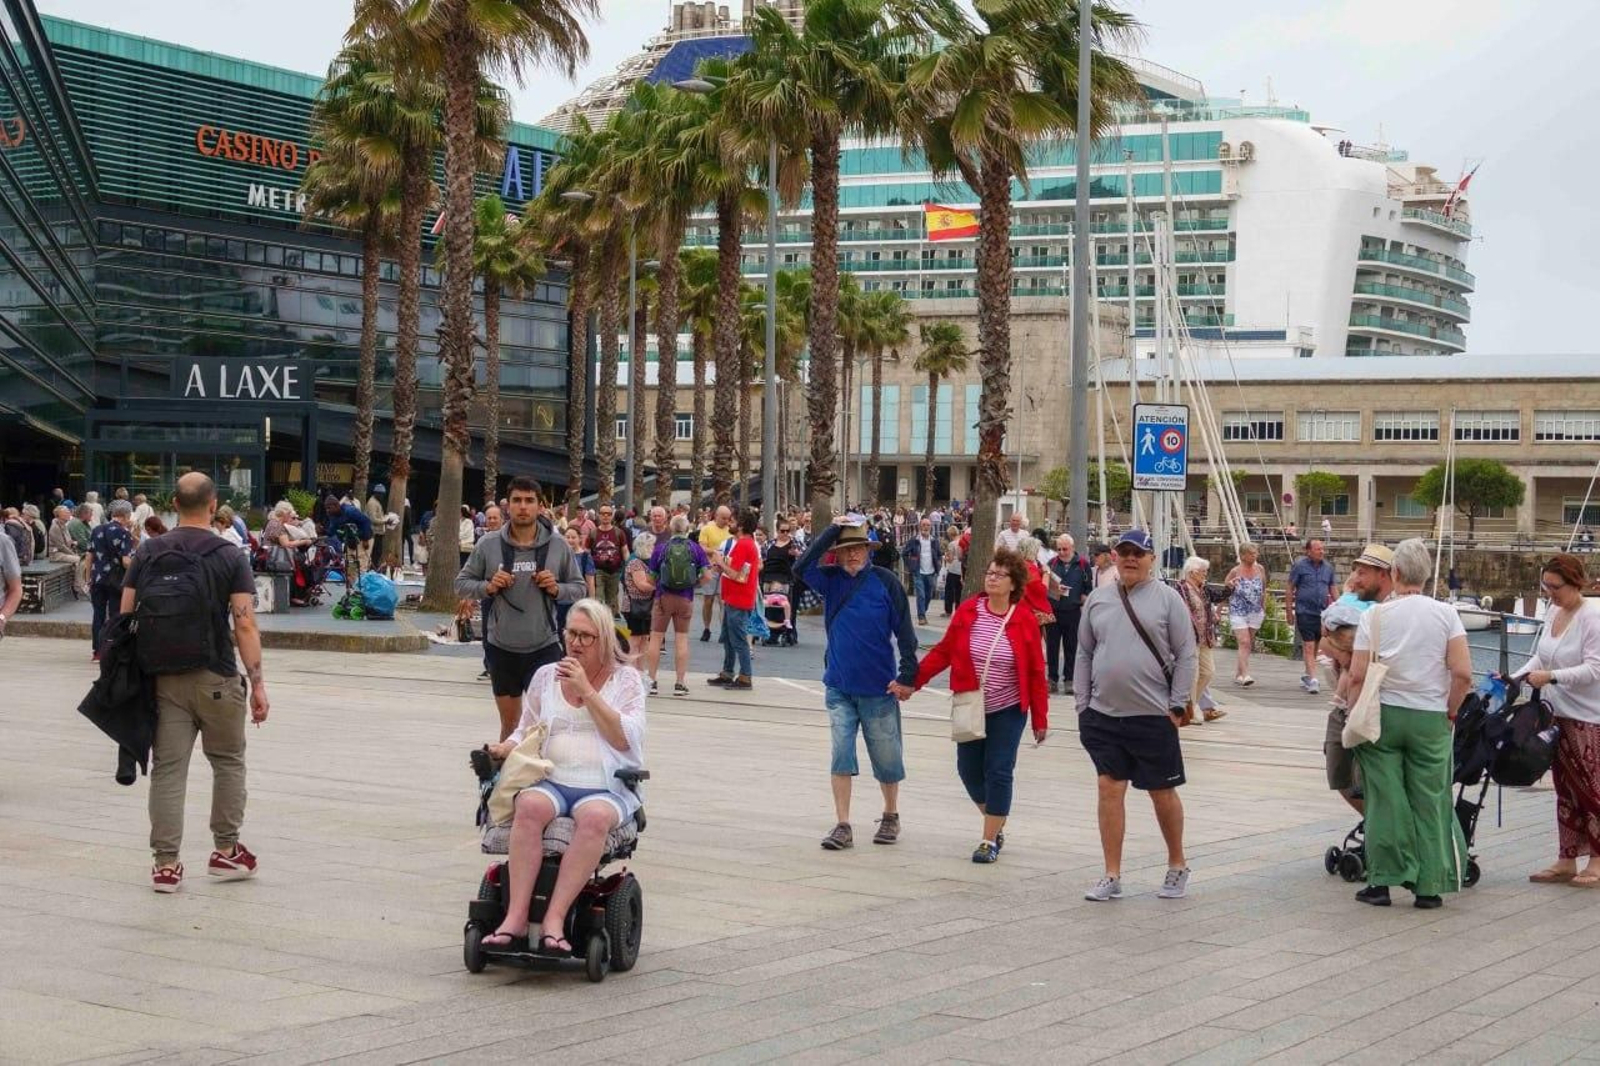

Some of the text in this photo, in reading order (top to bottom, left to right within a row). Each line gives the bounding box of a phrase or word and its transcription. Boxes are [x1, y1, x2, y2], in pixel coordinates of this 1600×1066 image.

[196, 124, 298, 170] CASINO
[184, 364, 301, 399] A LAXE
[1166, 436, 1178, 446] 10
